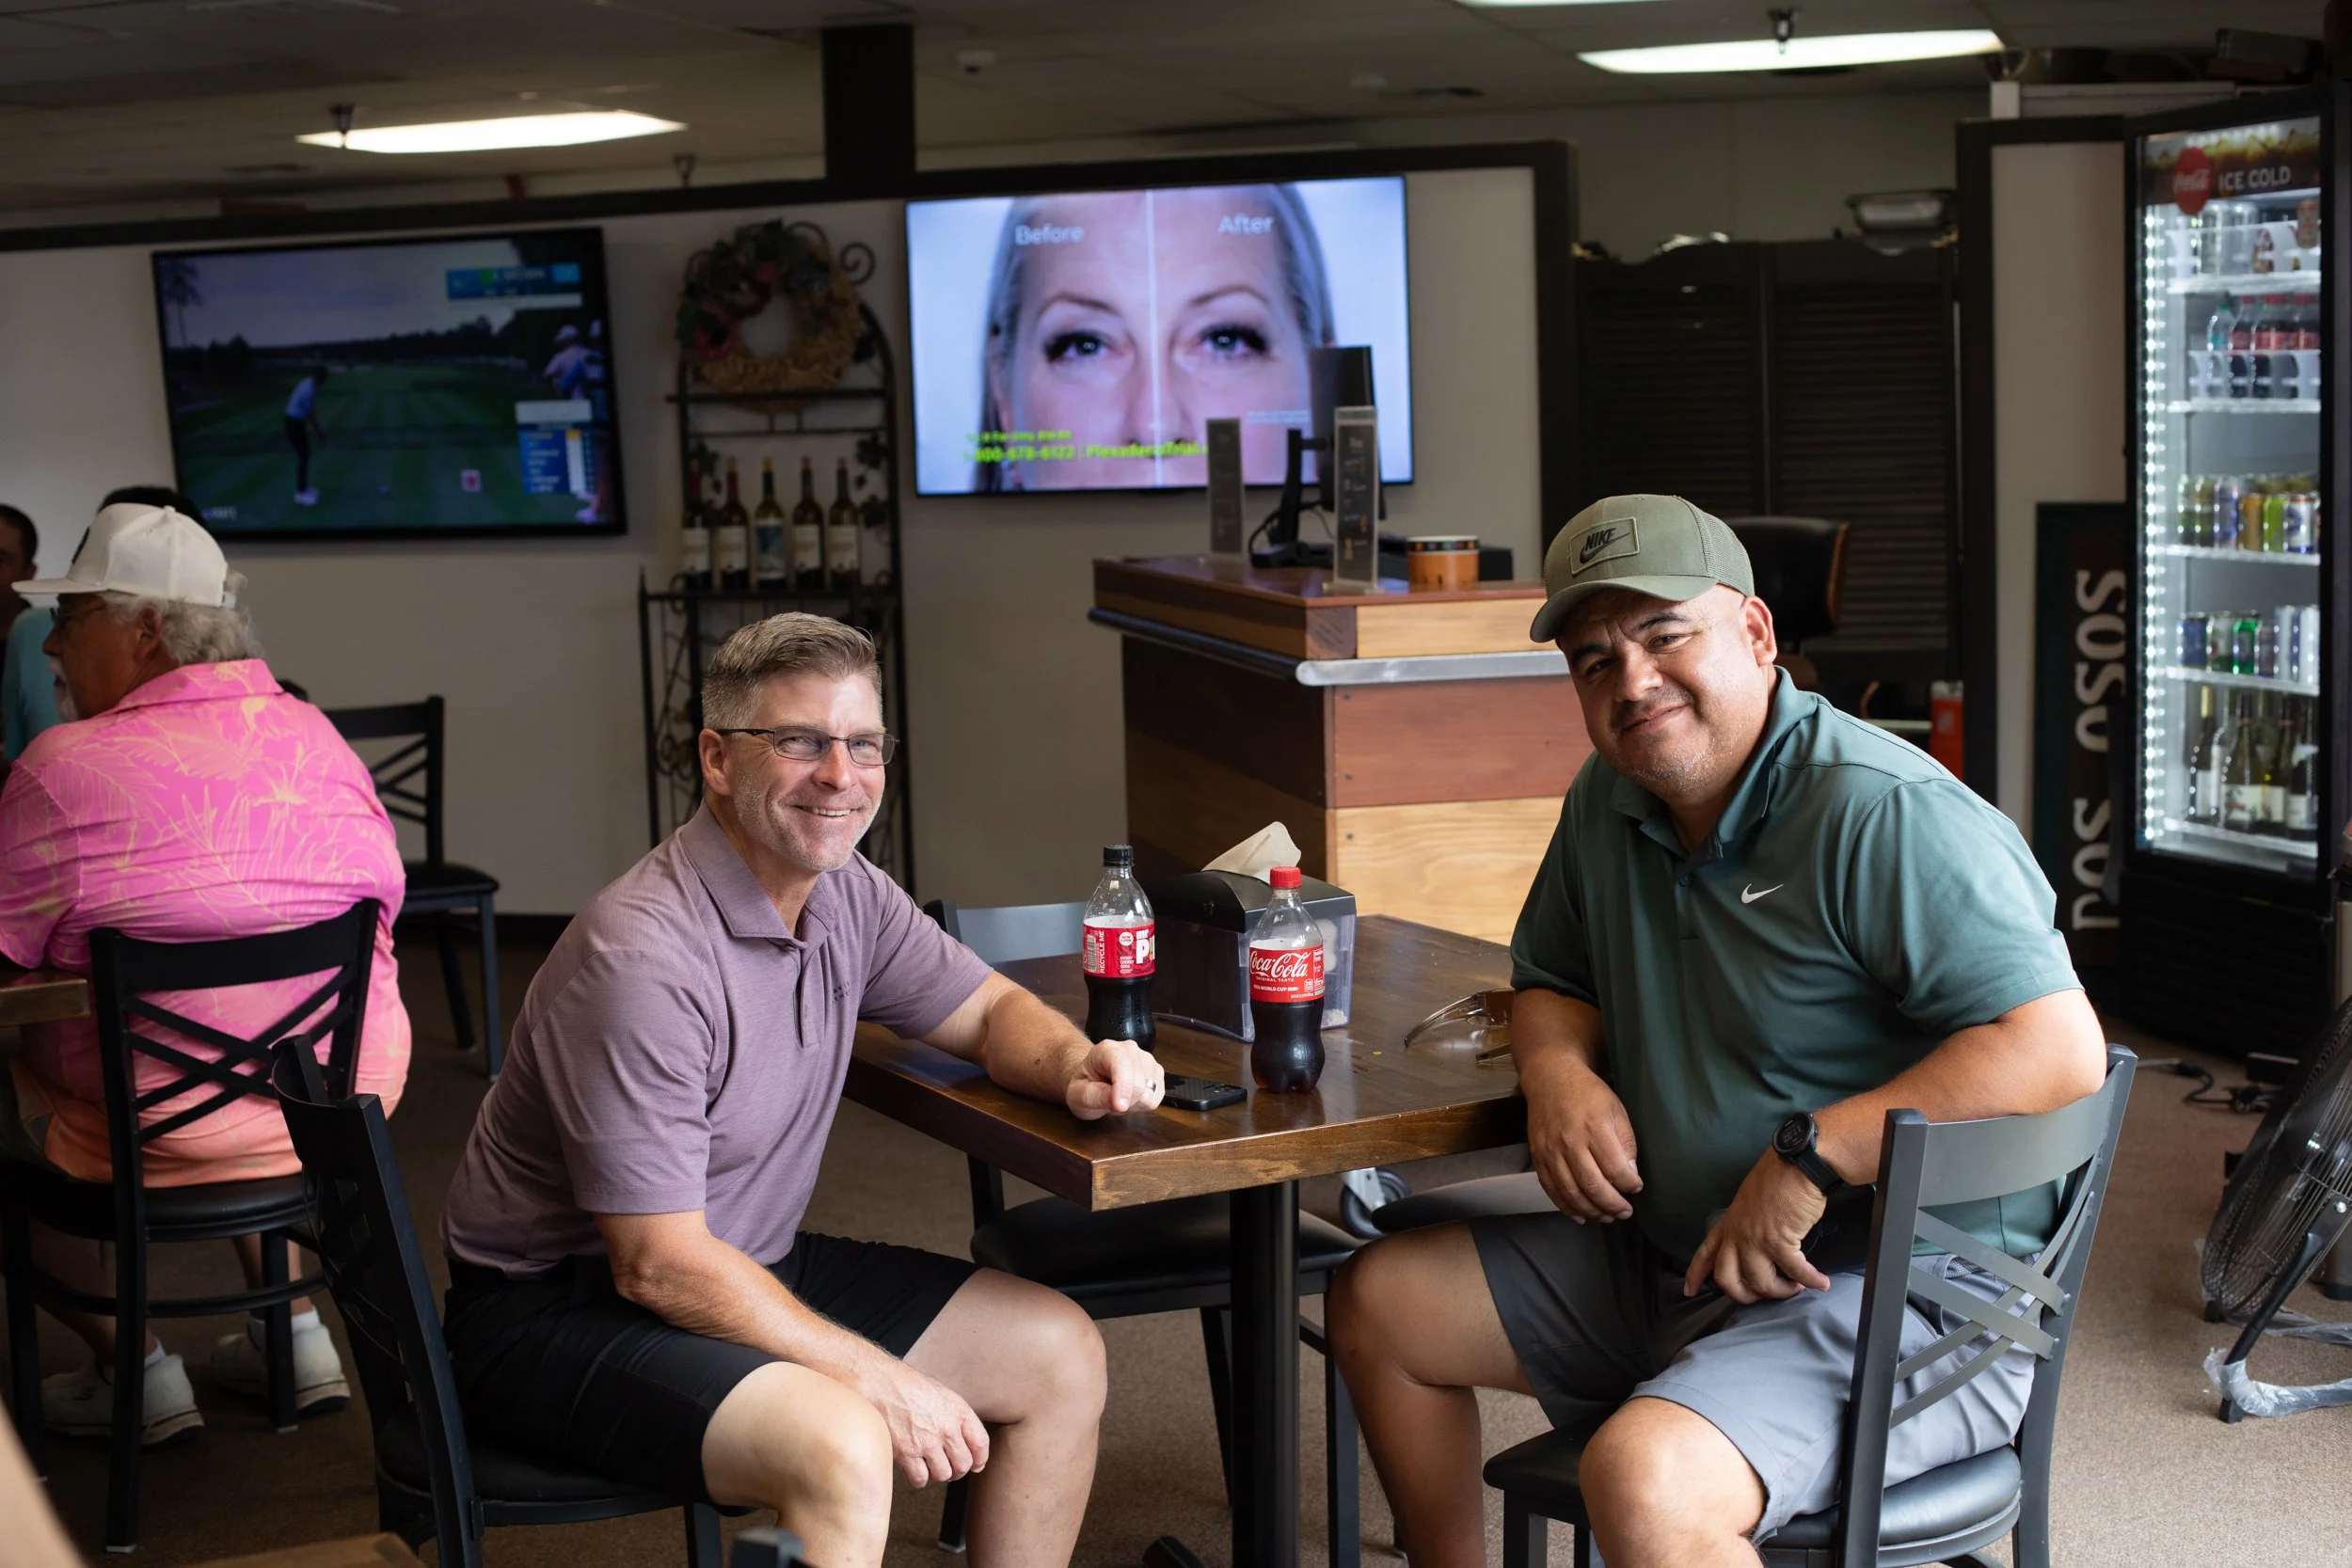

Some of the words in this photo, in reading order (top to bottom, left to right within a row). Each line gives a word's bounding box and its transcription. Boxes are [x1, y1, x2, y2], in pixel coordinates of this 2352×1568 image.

[2217, 170, 2245, 191] ICE
[2248, 166, 2292, 189] COLD
[1014, 223, 1085, 246] Before
[1218, 214, 1274, 236] After
[1583, 527, 1616, 551] NIKE
[2073, 569, 2127, 752] OSOS
[1099, 930, 1104, 942] ME
[1136, 929, 1149, 939] mr
[1249, 951, 1311, 978] Coca-Cola
